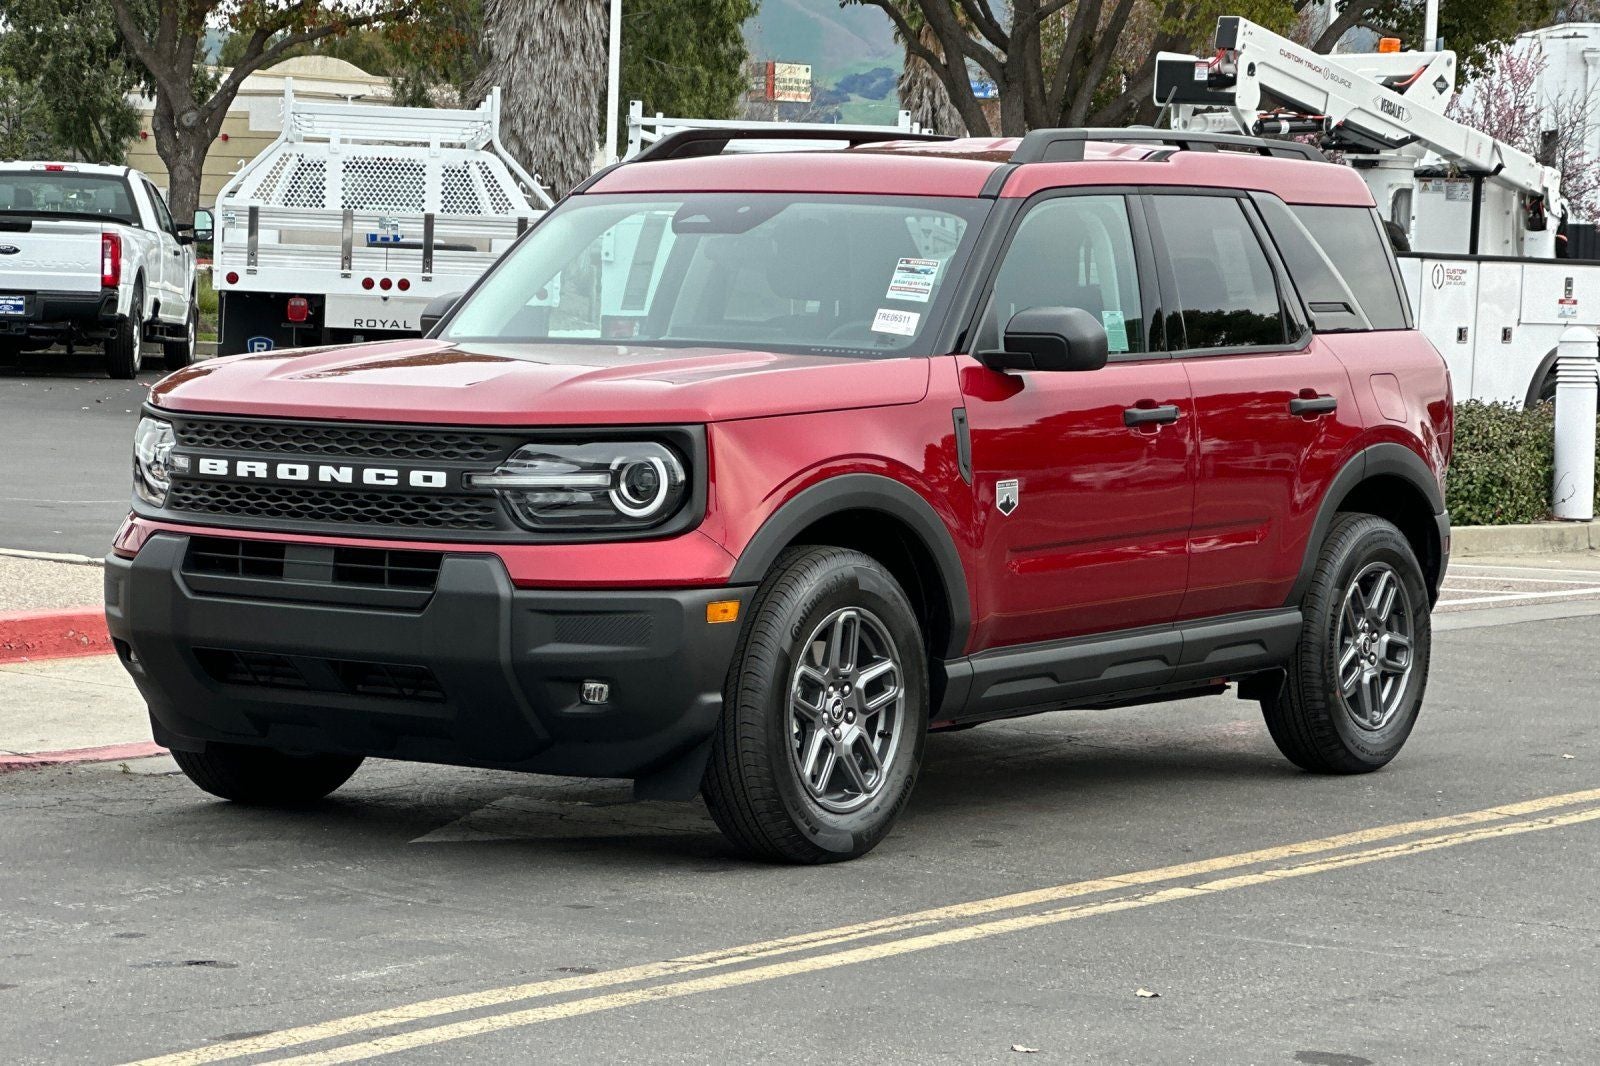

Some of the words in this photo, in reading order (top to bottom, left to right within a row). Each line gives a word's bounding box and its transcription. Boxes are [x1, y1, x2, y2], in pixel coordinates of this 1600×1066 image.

[1279, 48, 1304, 65] CUSTOM
[1304, 60, 1323, 75] TRUCK
[1330, 73, 1353, 89] SOURCE
[1380, 97, 1405, 121] VERSALIFT
[353, 318, 412, 329] ROYAL
[199, 458, 447, 488] BRONCO
